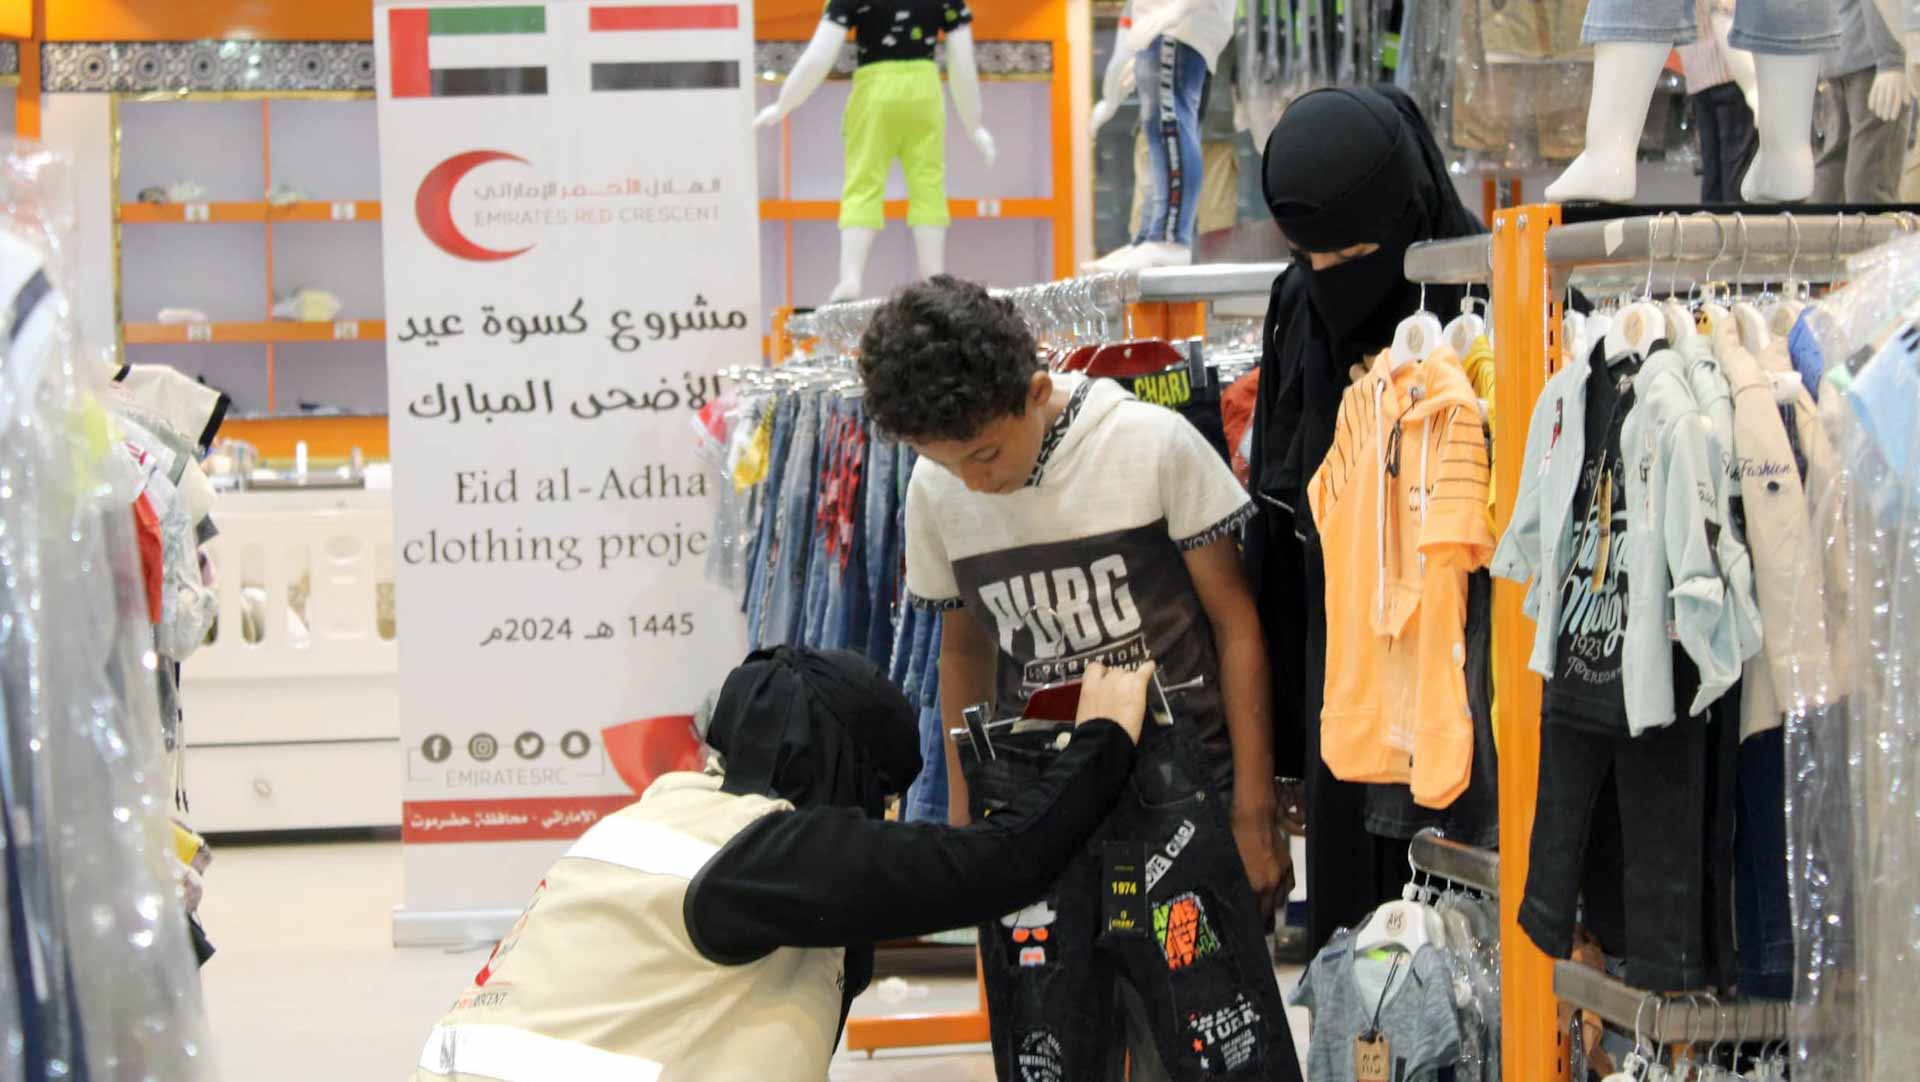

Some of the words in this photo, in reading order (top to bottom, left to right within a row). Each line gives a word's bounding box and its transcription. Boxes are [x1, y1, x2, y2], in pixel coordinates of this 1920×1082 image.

[474, 209, 567, 226] EMIRATES
[575, 207, 613, 225] RED
[618, 205, 720, 224] CRESCENT
[397, 314, 465, 347] عيد
[482, 297, 588, 344] كسوة
[609, 293, 748, 352] مشروع
[408, 379, 555, 424] المبارك
[570, 370, 723, 419] الأضحى
[1134, 369, 1191, 406] CHARJ
[455, 468, 519, 504] Eid
[535, 464, 708, 502] al-Adha
[402, 527, 584, 570] clothing
[628, 612, 695, 637] 1445
[978, 553, 1142, 660] PUBG
[1570, 633, 1601, 660] 1923
[445, 767, 570, 788] EMIRATESRC
[1111, 881, 1137, 895] 1974
